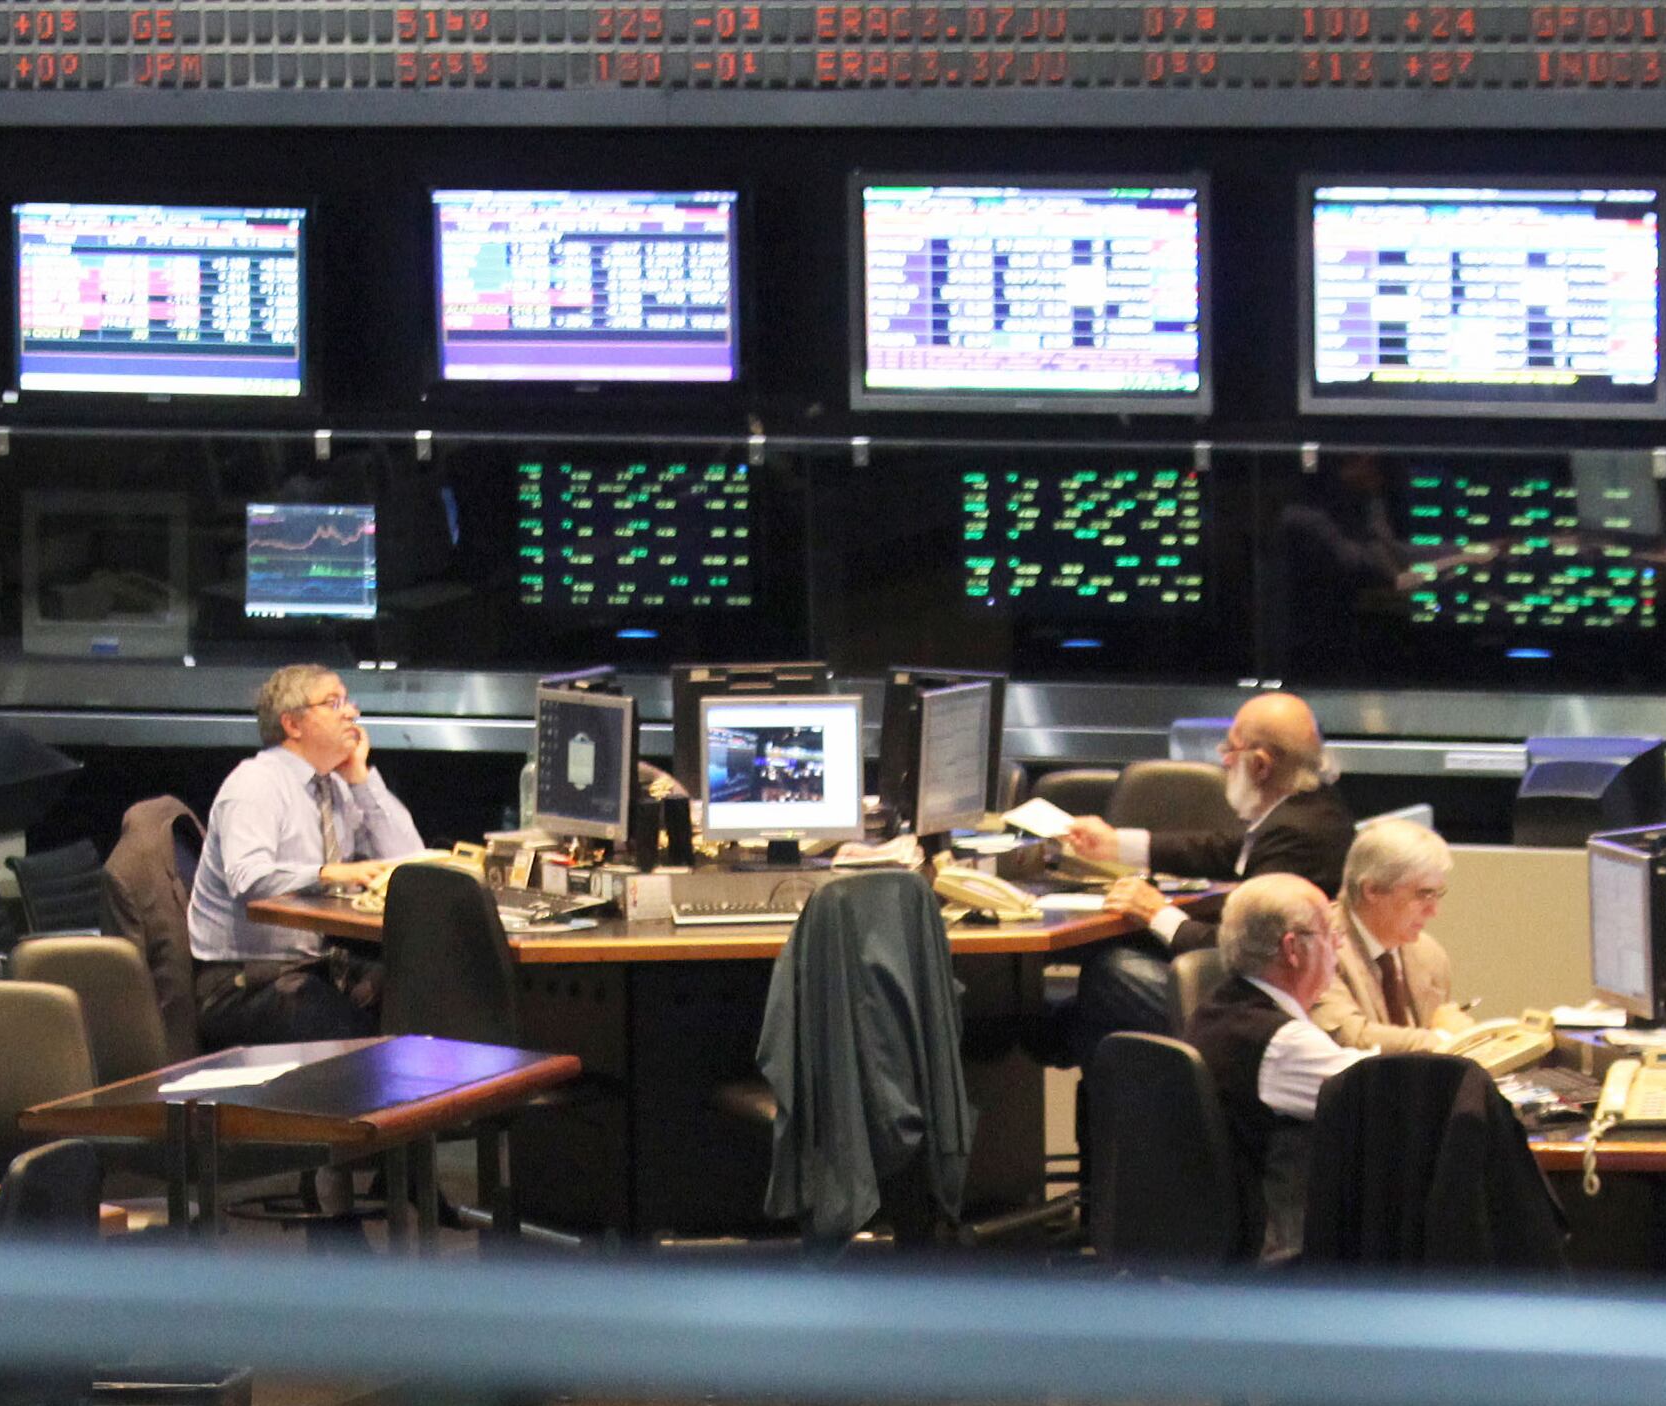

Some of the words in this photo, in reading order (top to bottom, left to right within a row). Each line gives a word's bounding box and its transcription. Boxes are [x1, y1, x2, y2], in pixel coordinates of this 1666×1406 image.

[133, 10, 174, 40] GE
[1407, 10, 1476, 38] +24
[139, 53, 202, 82] JPM
